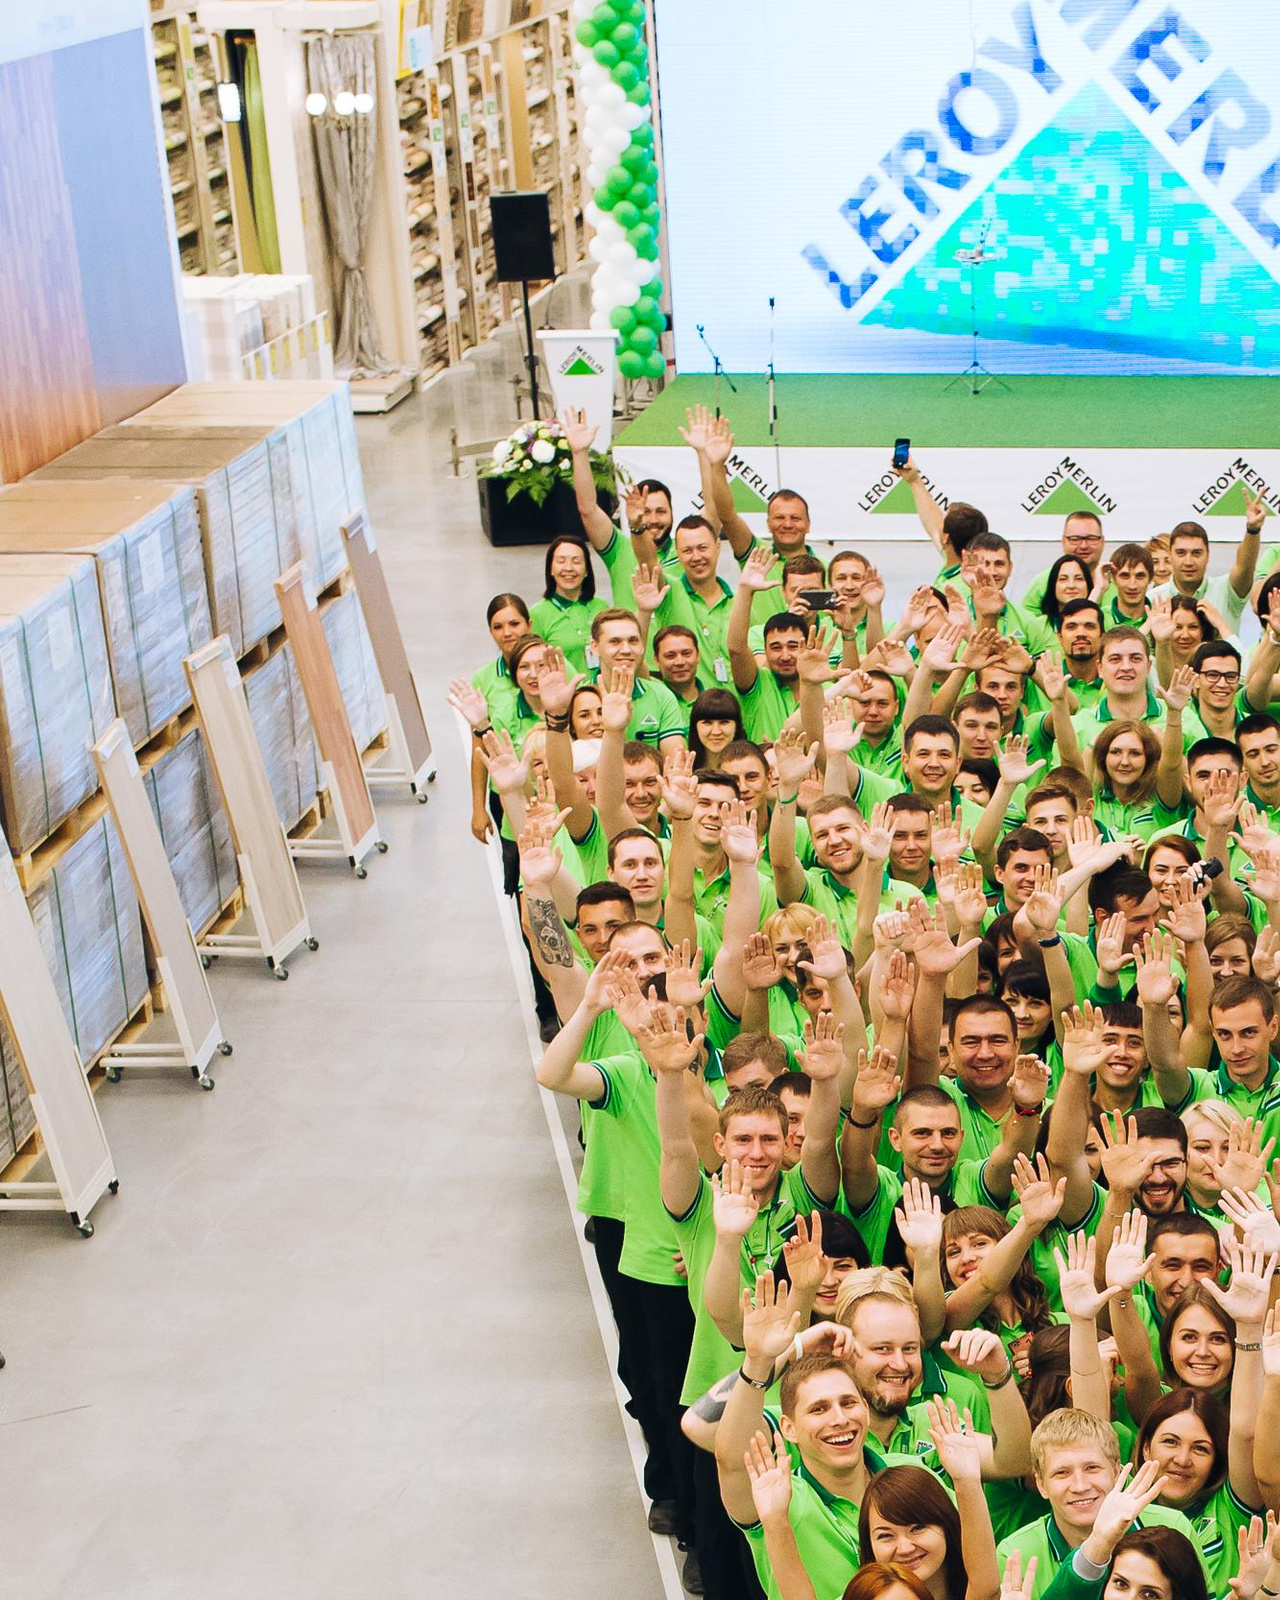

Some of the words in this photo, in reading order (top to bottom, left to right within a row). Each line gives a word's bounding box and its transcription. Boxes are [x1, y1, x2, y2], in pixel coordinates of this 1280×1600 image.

[800, 0, 1064, 311] LEROY
[729, 454, 777, 501] MERLI
[1020, 466, 1064, 513] LEROY
[1060, 456, 1118, 513] MERLIN
[1192, 467, 1236, 514] LEROY
